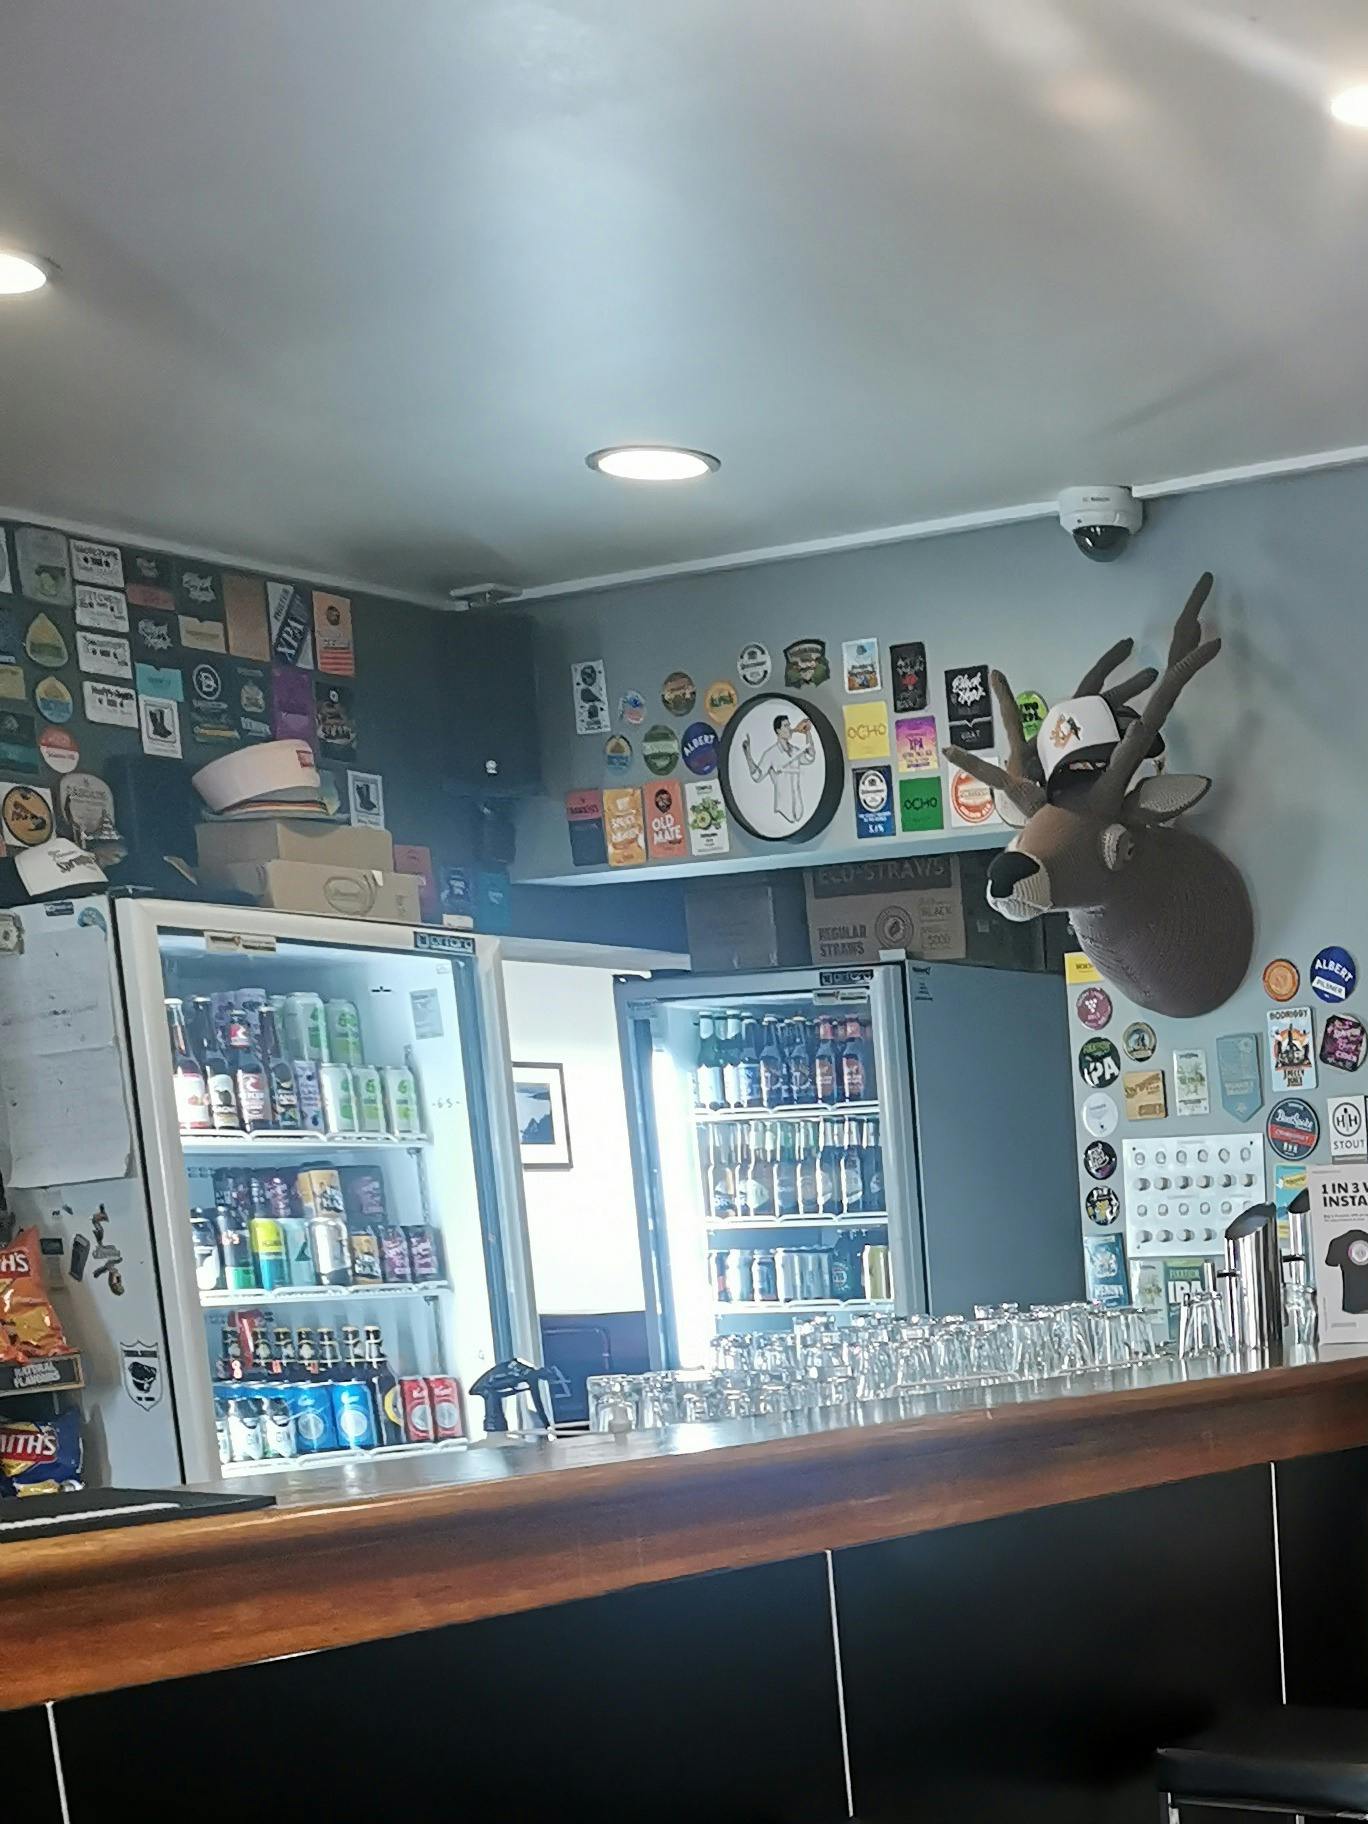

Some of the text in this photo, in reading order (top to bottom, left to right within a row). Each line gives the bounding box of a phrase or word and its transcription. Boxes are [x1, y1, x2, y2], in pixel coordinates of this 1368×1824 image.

[847, 723, 888, 741] OCHO
[903, 797, 938, 811] OCHO
[651, 813, 675, 830] OLD
[652, 825, 683, 844] MATE
[1314, 958, 1354, 983] ALBERT
[1083, 1057, 1120, 1089] IPA
[1333, 1139, 1366, 1151] STOUT
[1321, 1184, 1327, 1195] 1
[1333, 1183, 1349, 1194] IN
[1353, 1182, 1360, 1193] 3
